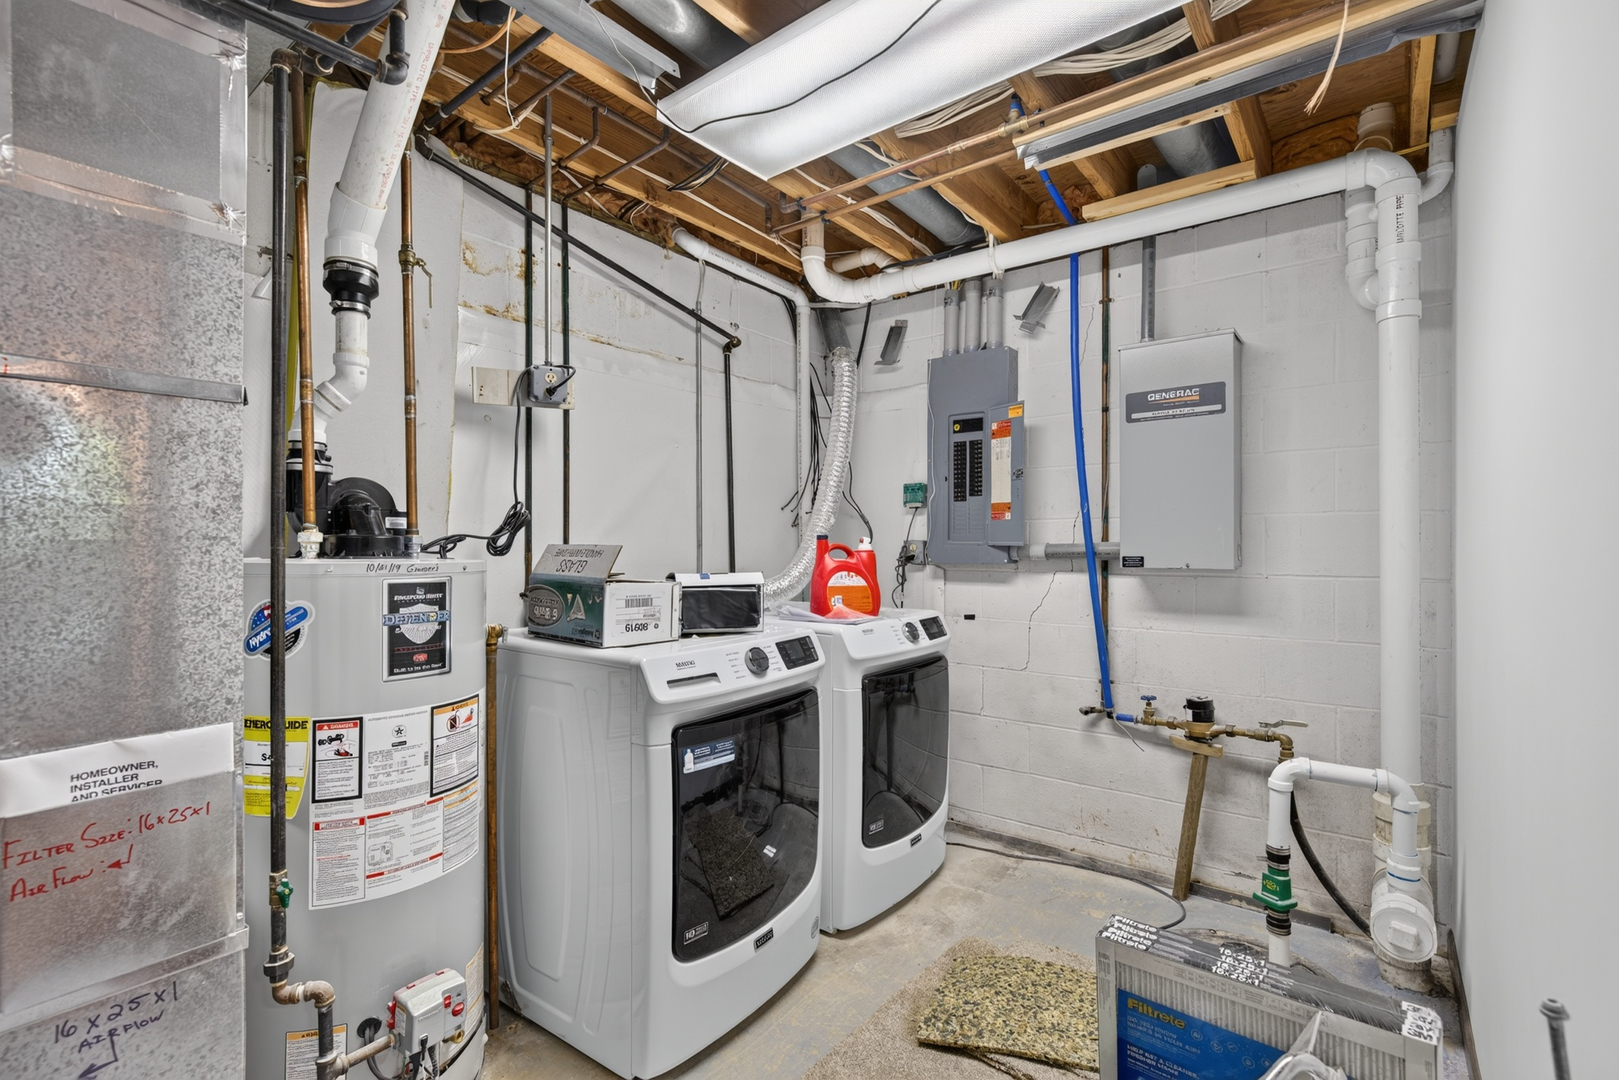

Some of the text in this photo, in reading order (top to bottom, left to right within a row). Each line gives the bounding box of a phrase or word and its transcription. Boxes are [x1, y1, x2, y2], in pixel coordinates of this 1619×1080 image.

[1147, 388, 1200, 401] GENERAC
[556, 559, 588, 574] GLASS
[383, 610, 450, 626] DEFENDER
[70, 760, 159, 782] HOMEOWNER,
[70, 773, 139, 793] INSTALLER
[71, 791, 98, 803] AND
[1127, 997, 1186, 1029] Filtrete
